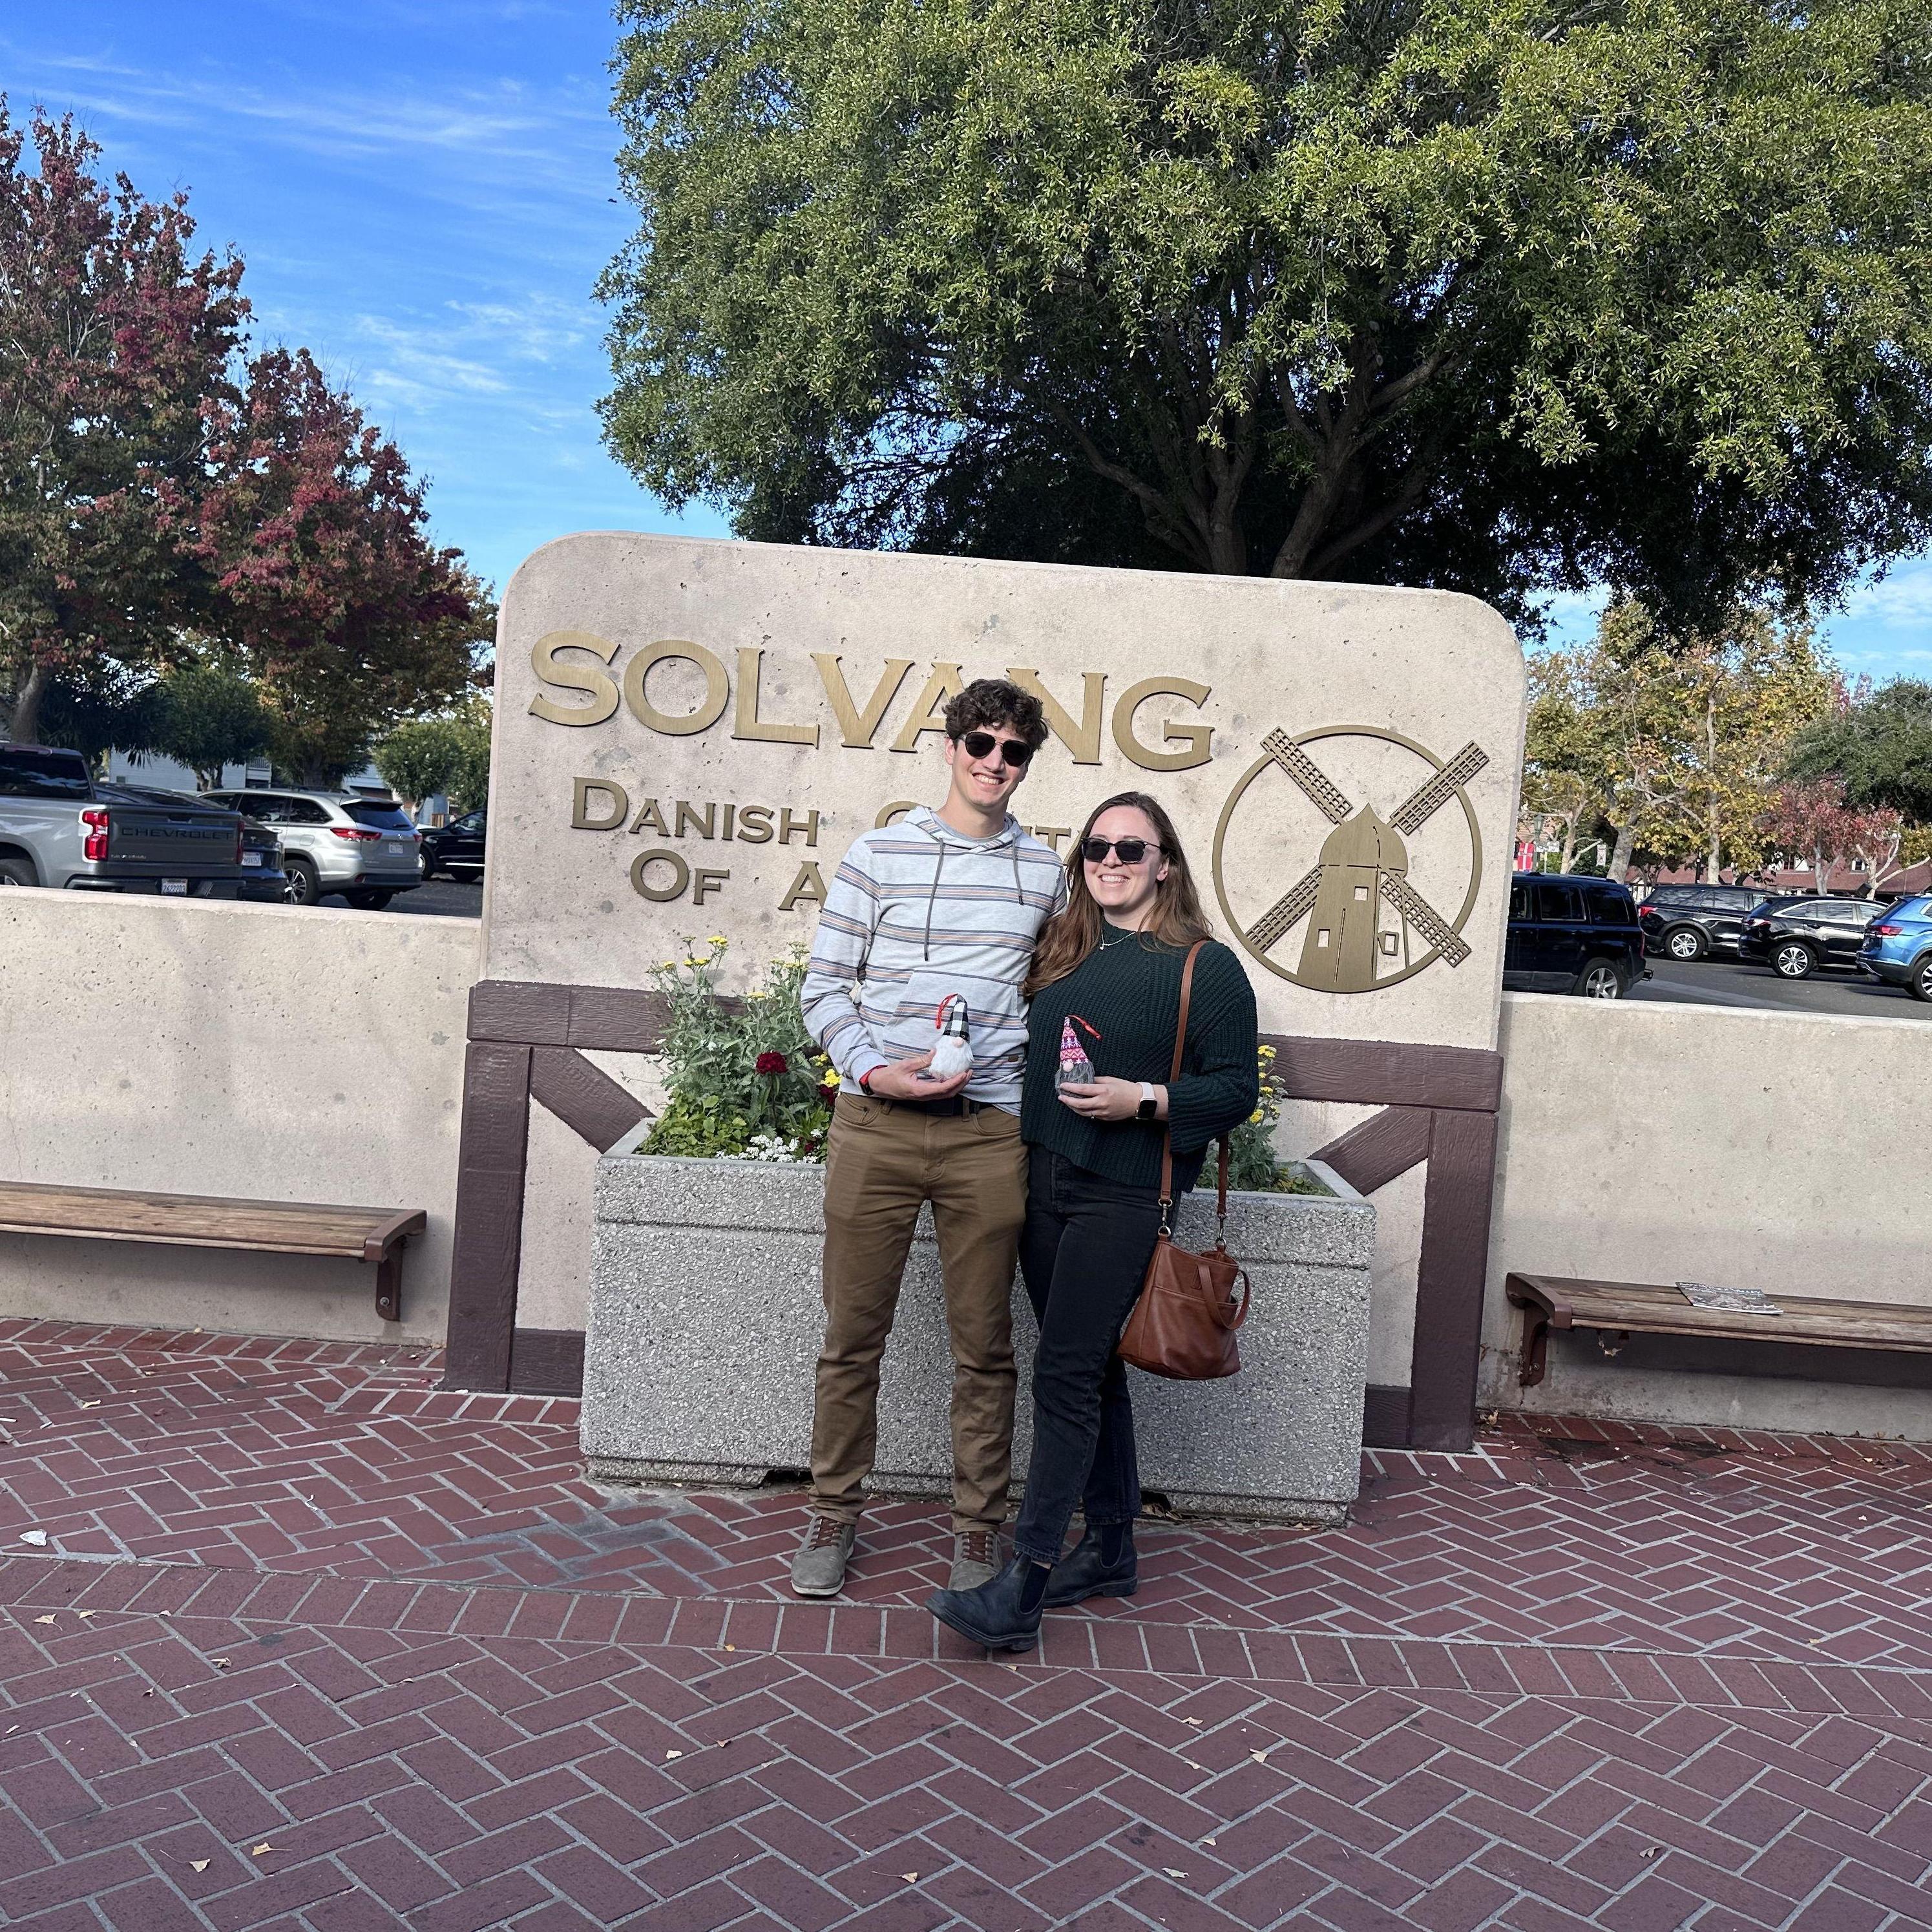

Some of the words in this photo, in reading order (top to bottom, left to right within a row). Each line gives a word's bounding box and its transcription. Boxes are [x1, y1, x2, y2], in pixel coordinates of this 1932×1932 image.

[121, 826, 233, 841] CHEVROLET
[570, 776, 820, 847] DANISH
[630, 848, 730, 905] OF
